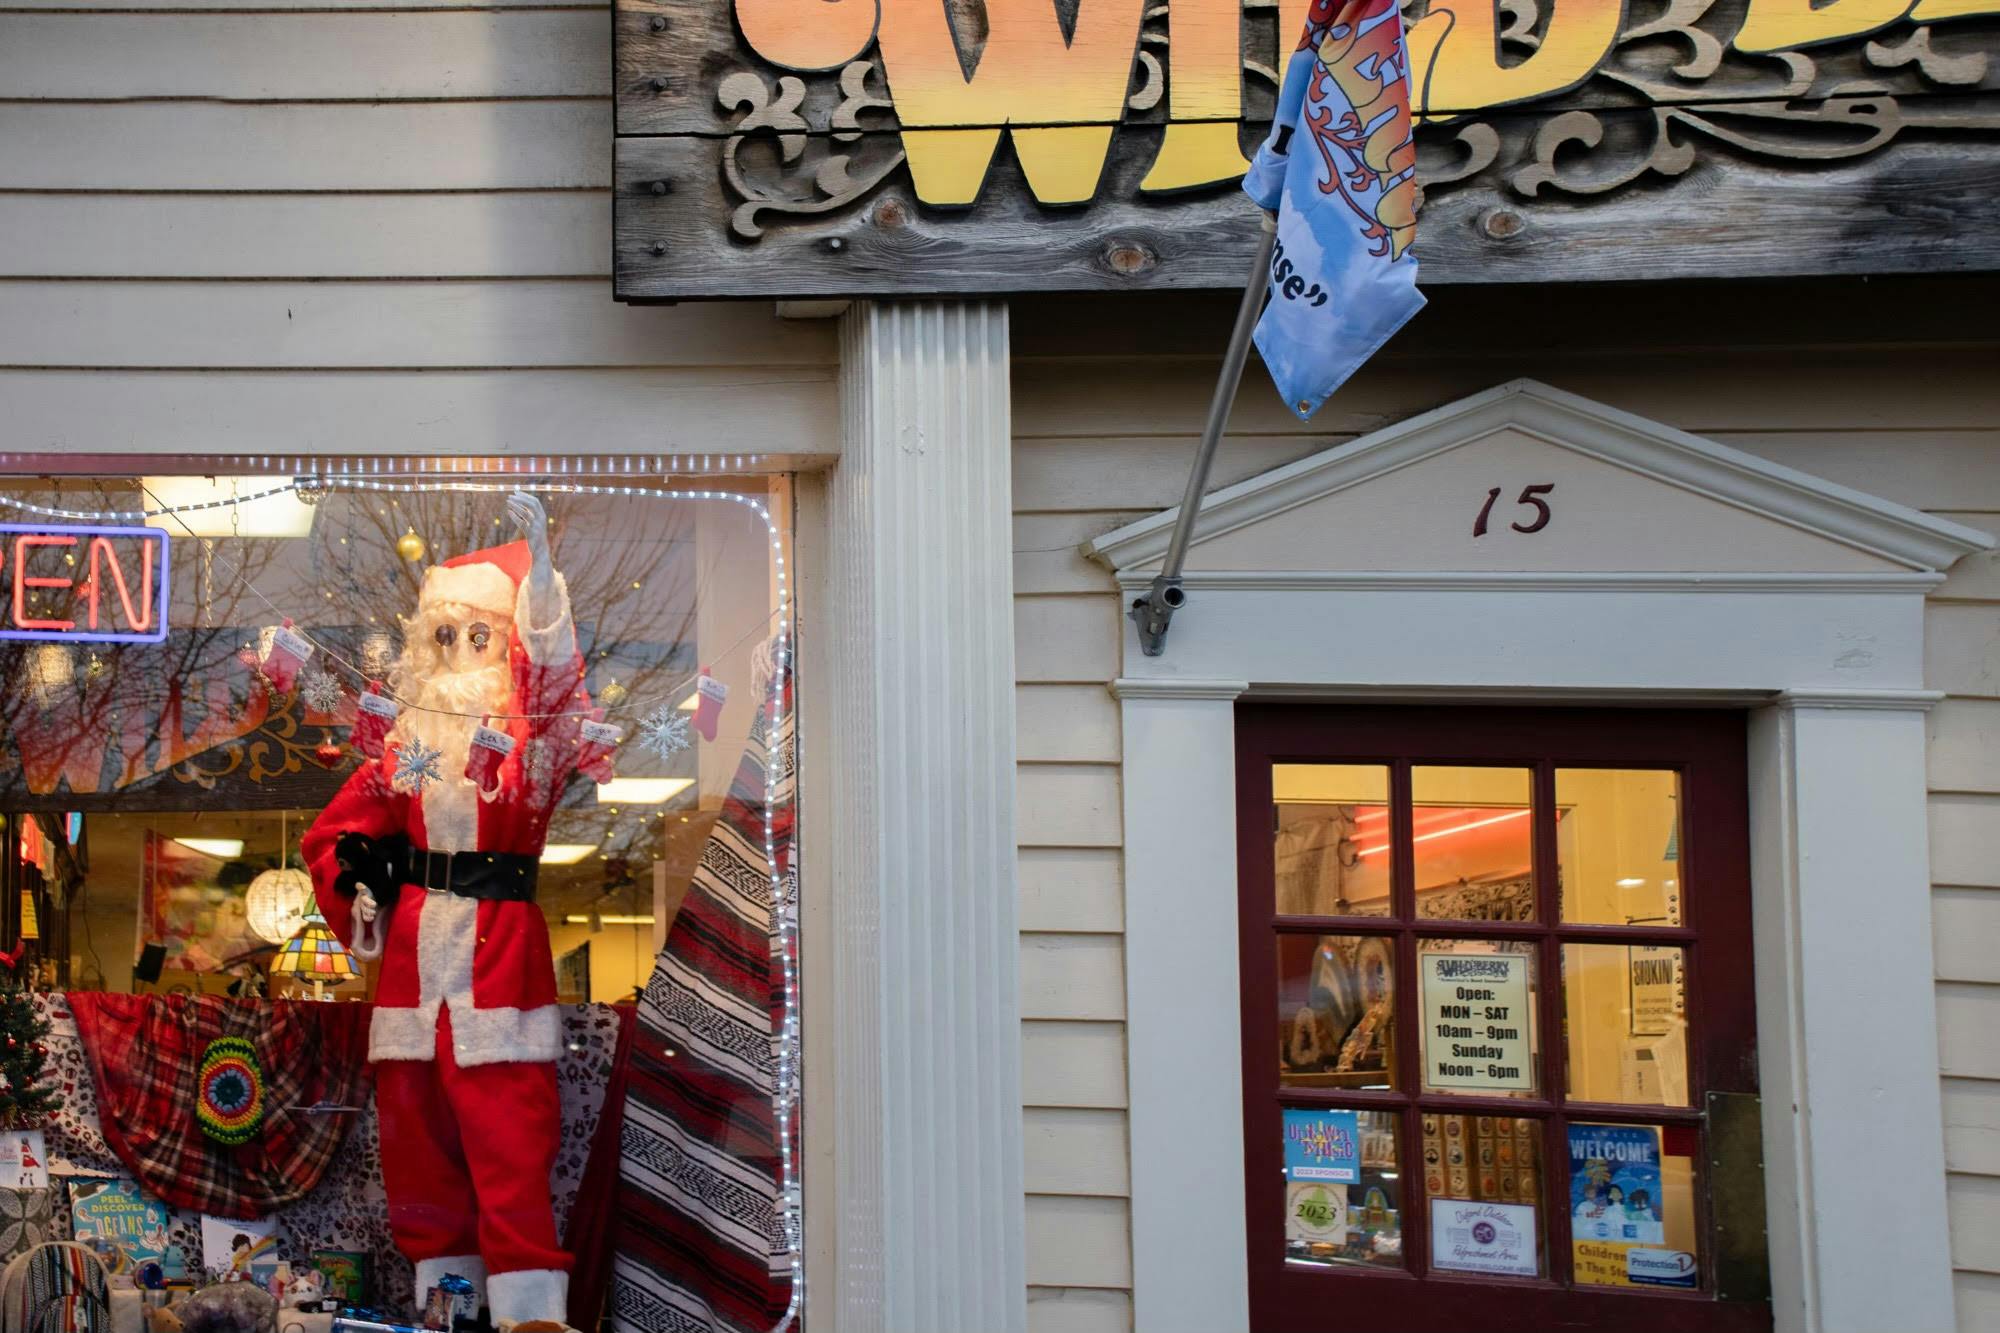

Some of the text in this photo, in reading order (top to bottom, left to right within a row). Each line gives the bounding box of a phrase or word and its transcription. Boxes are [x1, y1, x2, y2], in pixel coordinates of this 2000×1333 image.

[1473, 483, 1555, 537] 15
[0, 534, 153, 632] EN
[1633, 959, 1673, 986] SMOKIN
[1456, 986, 1496, 1002] Open:
[1440, 1005, 1471, 1020] MON
[1485, 1006, 1510, 1021] SAT
[1436, 1024, 1473, 1039] 10am
[1486, 1025, 1518, 1041] 9pm
[1452, 1043, 1504, 1060] Sunday
[1438, 1062, 1474, 1077] Noon
[1488, 1064, 1519, 1079] 6pm
[1569, 1139, 1651, 1163] WELCOME
[91, 1203, 145, 1213] DISCOVER
[101, 1195, 124, 1203] PEEL
[1295, 1203, 1338, 1221] 2023
[96, 1215, 143, 1240] OCEANS
[1577, 1243, 1627, 1262] Children
[1575, 1261, 1628, 1279] n The Sto
